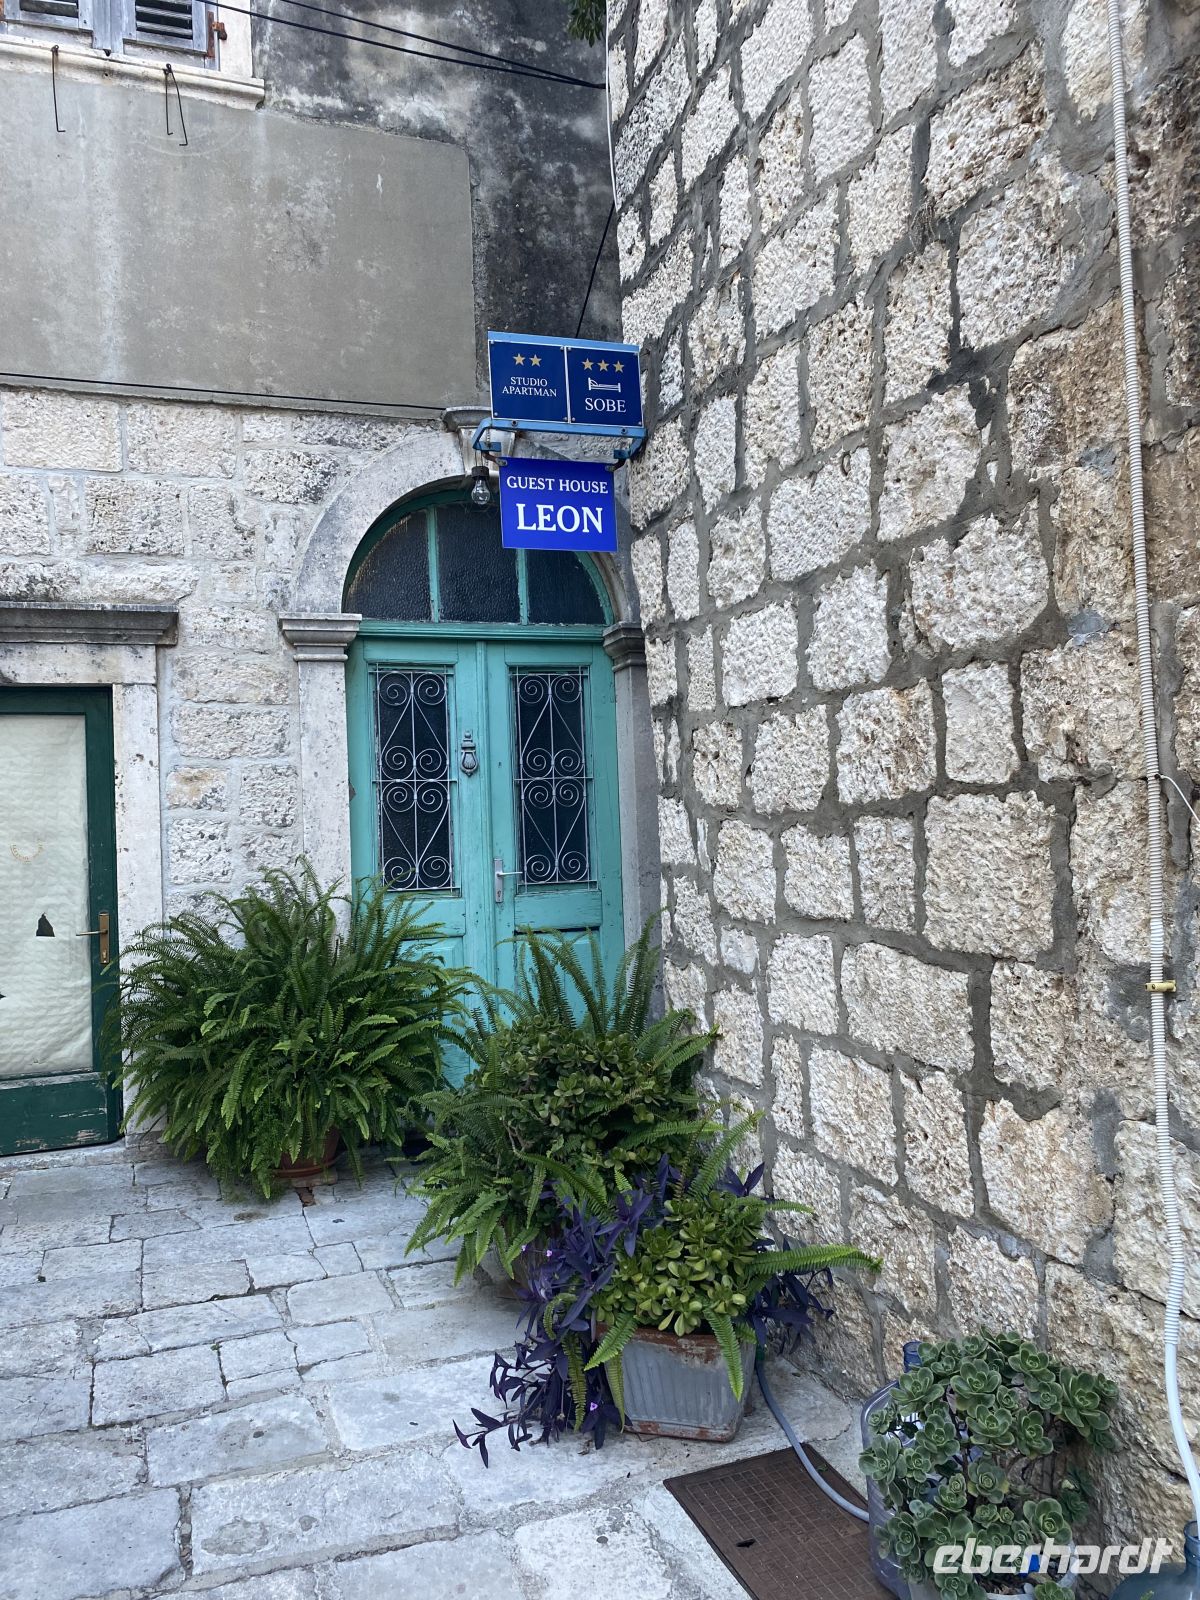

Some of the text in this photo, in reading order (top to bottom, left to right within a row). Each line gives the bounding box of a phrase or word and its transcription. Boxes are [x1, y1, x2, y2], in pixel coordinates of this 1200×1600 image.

[510, 377, 548, 386] STUDIO
[502, 386, 557, 397] APARTMAN
[585, 398, 626, 412] SOBE
[507, 476, 608, 493] GUEST HOUSE
[516, 503, 603, 533] LEON
